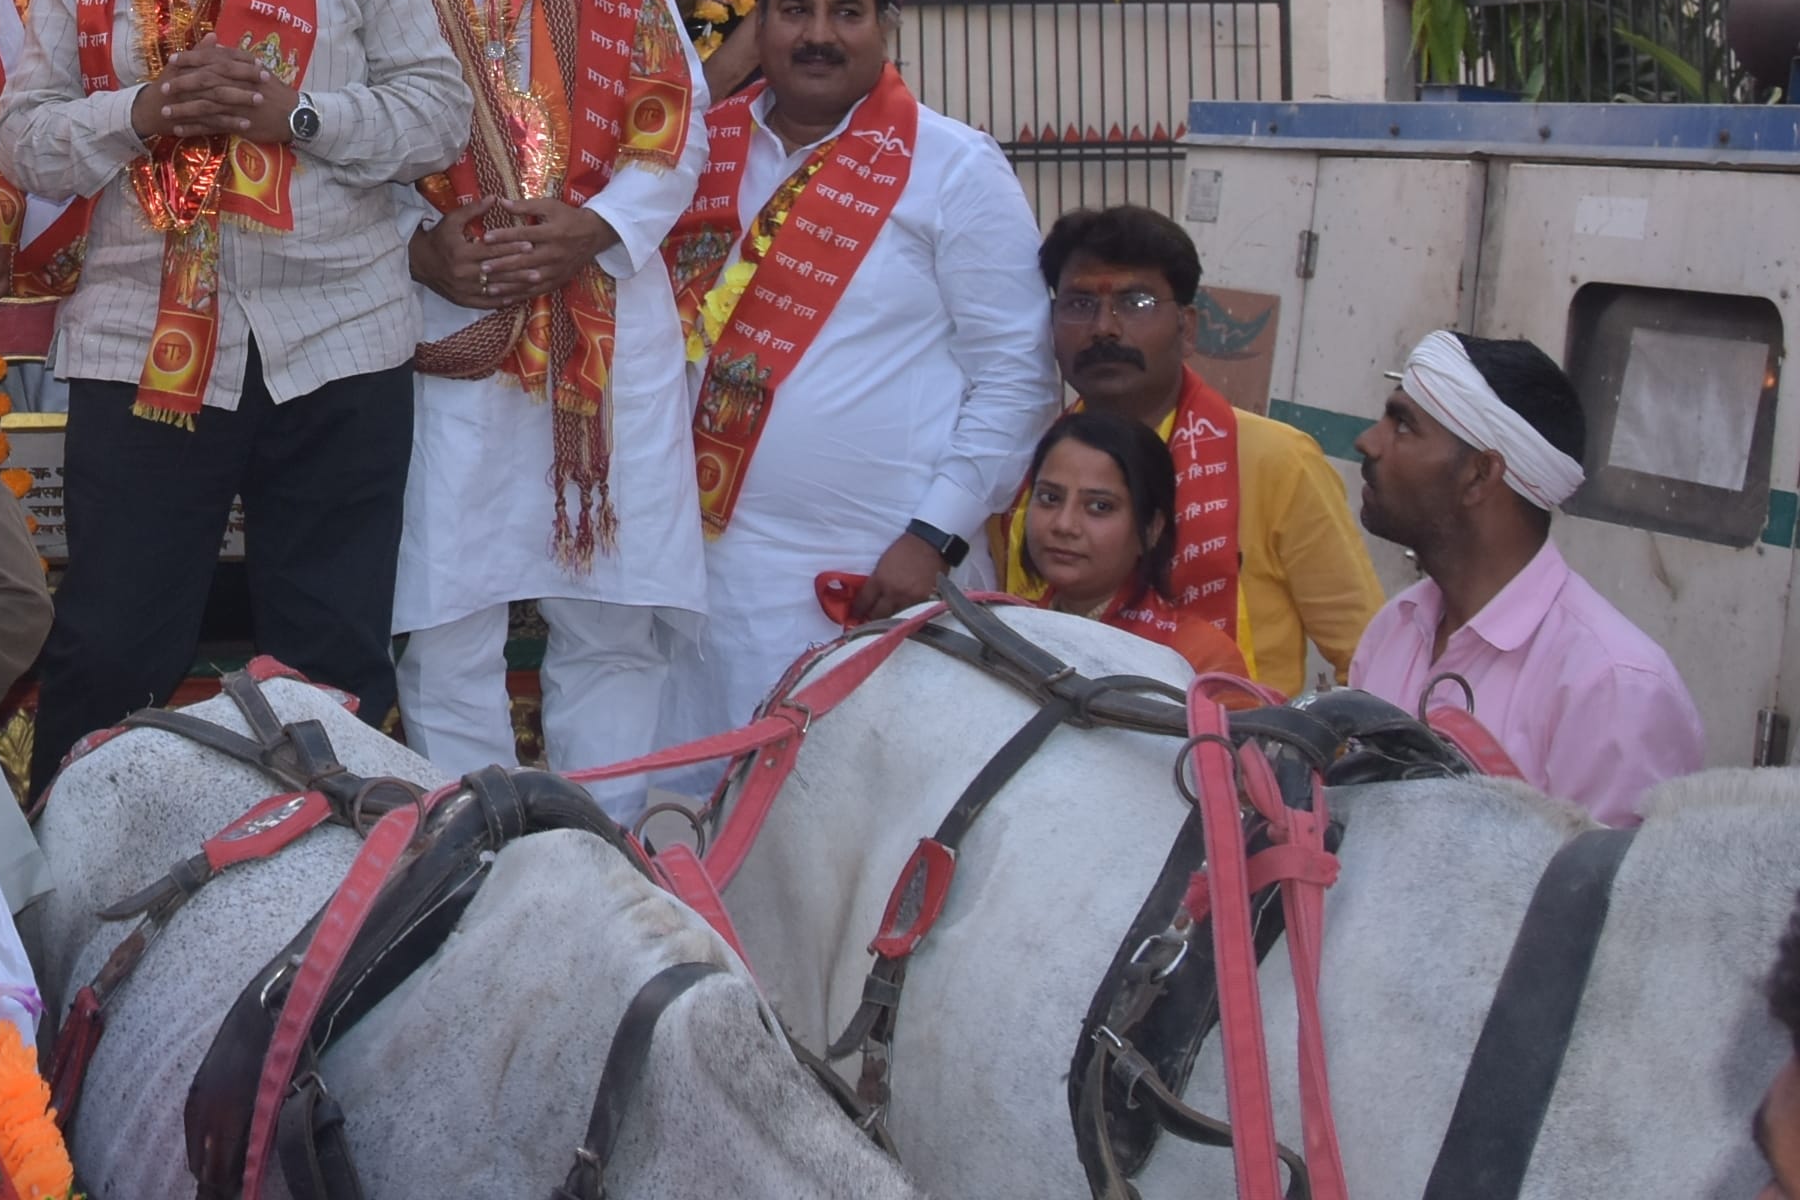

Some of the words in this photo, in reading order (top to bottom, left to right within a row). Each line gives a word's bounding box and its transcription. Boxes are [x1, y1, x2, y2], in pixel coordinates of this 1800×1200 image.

[90, 32, 107, 45] राम
[92, 75, 109, 87] राम
[721, 126, 741, 138] राम
[714, 161, 736, 173] राम
[835, 153, 856, 171] जय
[856, 162, 871, 180] श्री
[872, 170, 896, 186] राम
[710, 196, 730, 209] राम
[815, 183, 837, 201] जय
[838, 192, 853, 210] श्री
[854, 199, 880, 217] राम
[795, 216, 816, 233] जय
[817, 225, 833, 242] श्री
[834, 233, 859, 252] राम
[775, 251, 796, 269] जय
[797, 260, 813, 278] श्री
[814, 267, 839, 287] राम
[754, 285, 775, 303] जय
[775, 293, 792, 311] श्री
[793, 302, 818, 320] राम
[734, 320, 755, 338] जय
[754, 328, 771, 346] श्री
[772, 336, 796, 353] राम
